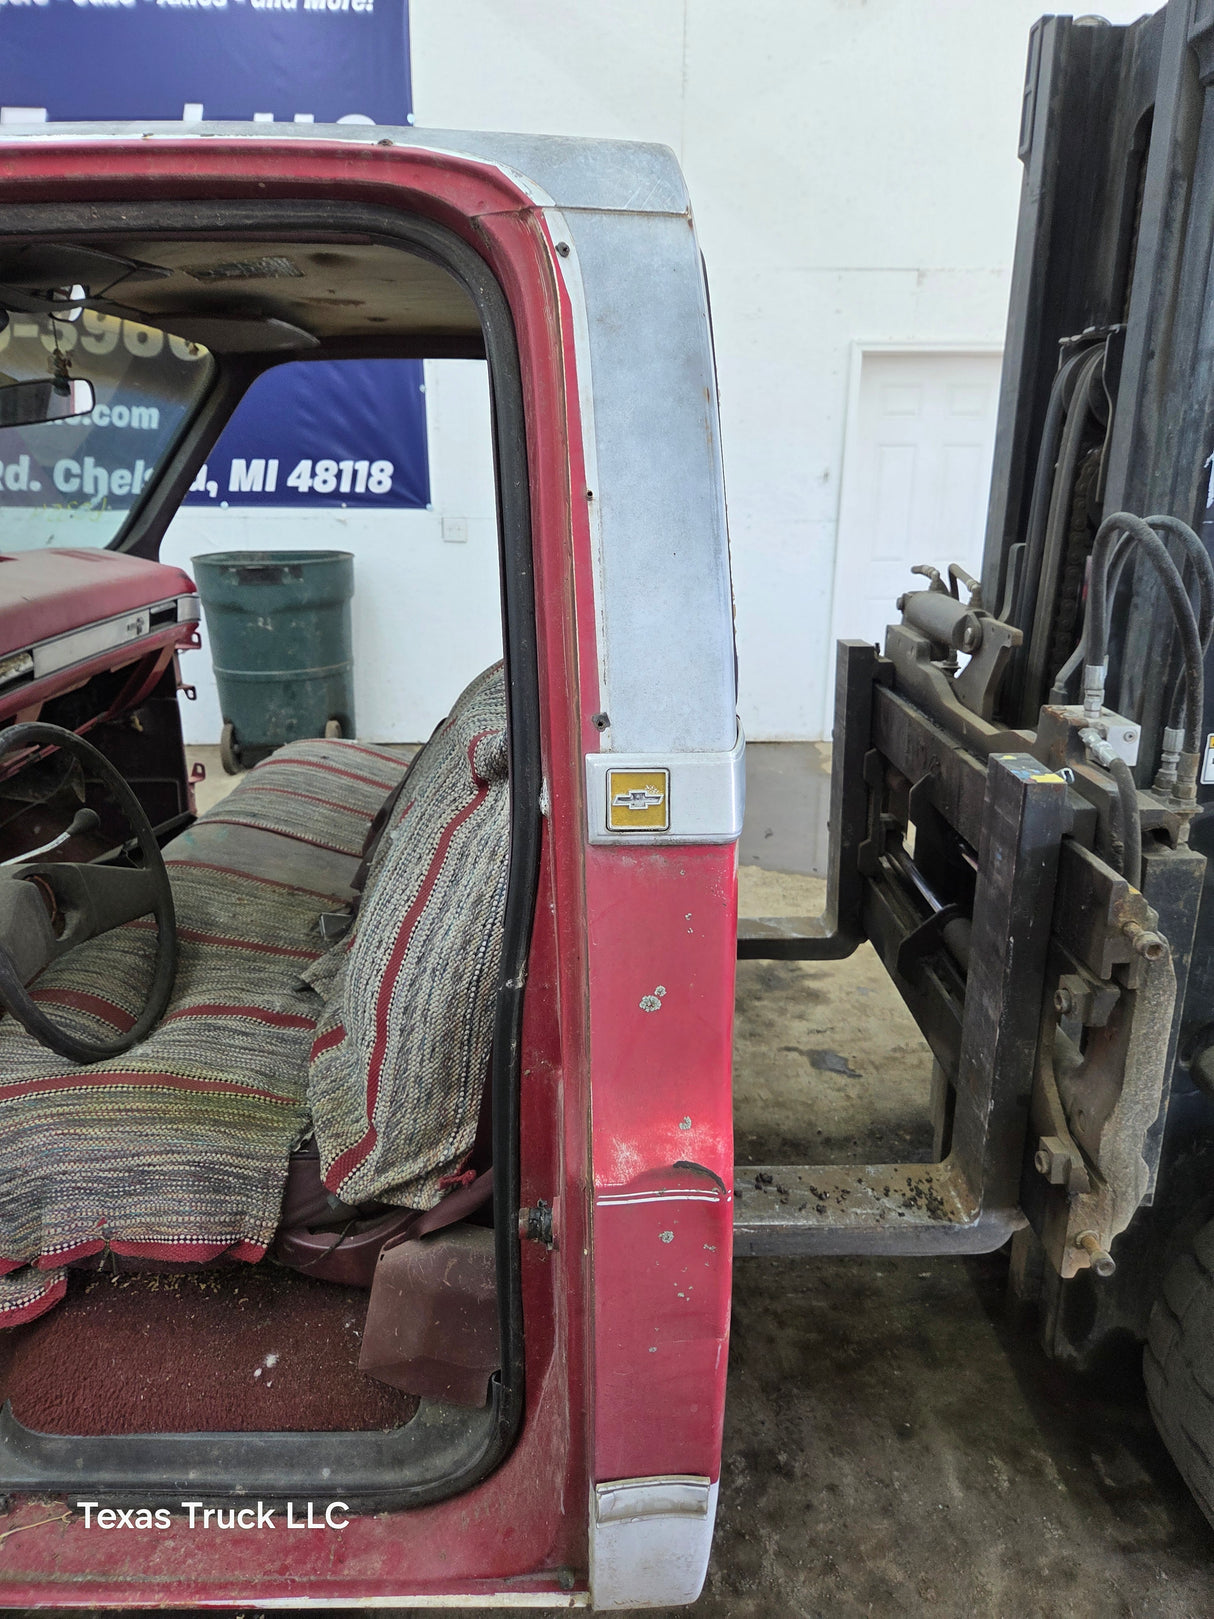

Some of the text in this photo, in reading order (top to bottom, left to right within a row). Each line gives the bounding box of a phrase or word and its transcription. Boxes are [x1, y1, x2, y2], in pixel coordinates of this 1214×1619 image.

[0, 454, 42, 492] d.
[228, 458, 279, 492] MI
[286, 459, 394, 494] 48118
